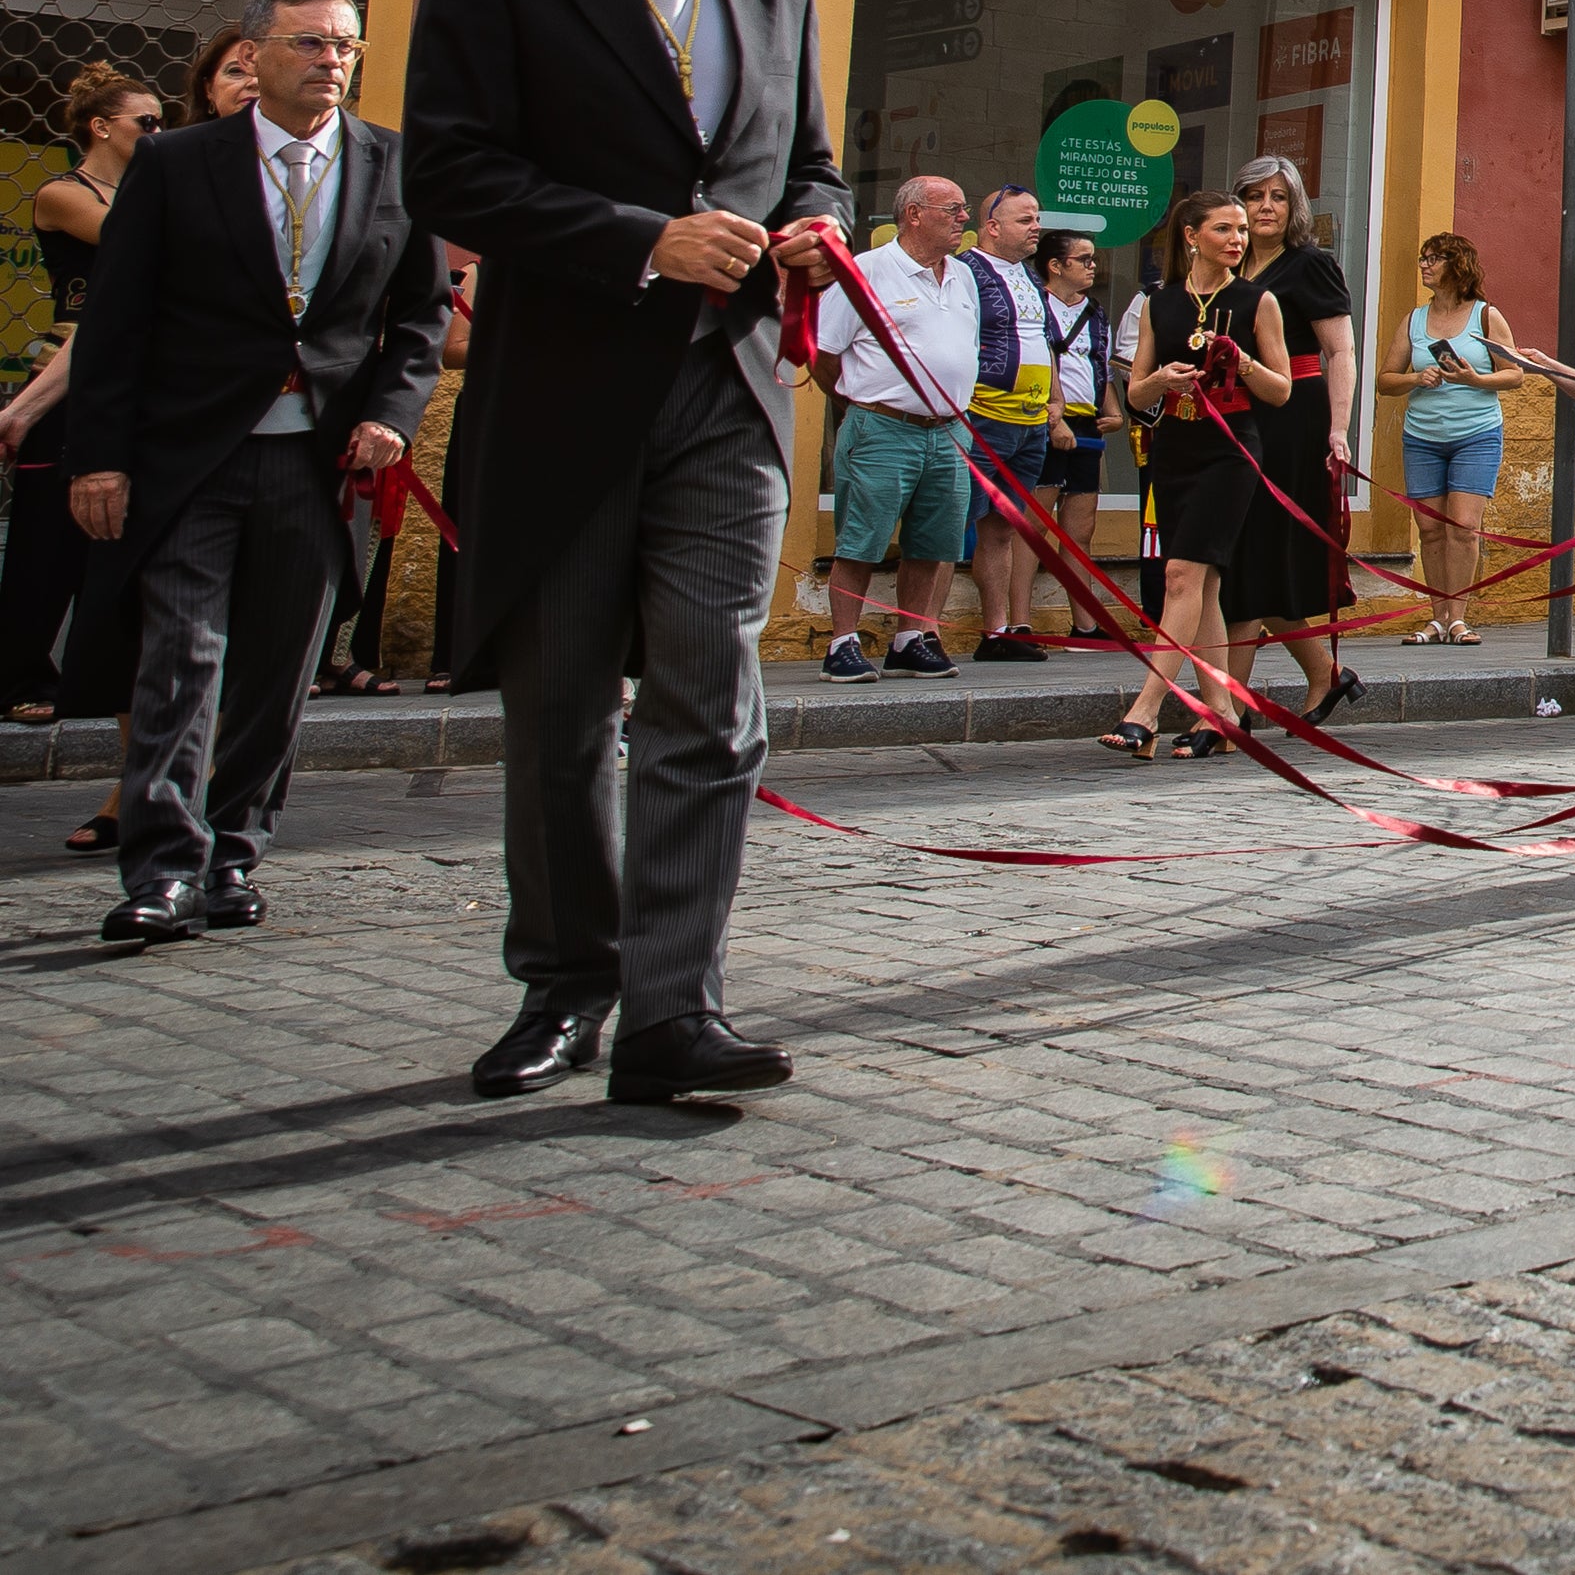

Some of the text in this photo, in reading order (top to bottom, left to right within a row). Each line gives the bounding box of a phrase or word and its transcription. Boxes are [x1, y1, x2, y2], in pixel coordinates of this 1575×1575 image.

[1291, 36, 1341, 67] FIBRA
[1131, 121, 1175, 133] populoos
[1263, 127, 1297, 142] Quedarte
[1061, 137, 1122, 152] ¿TE ESTÁS
[1060, 151, 1148, 168] MIRANDO EN EL
[1059, 165, 1138, 180] REFLEJO O ES
[1058, 179, 1149, 195] QUE TE QUIERES
[1057, 193, 1149, 209] HACER CLIENTE?
